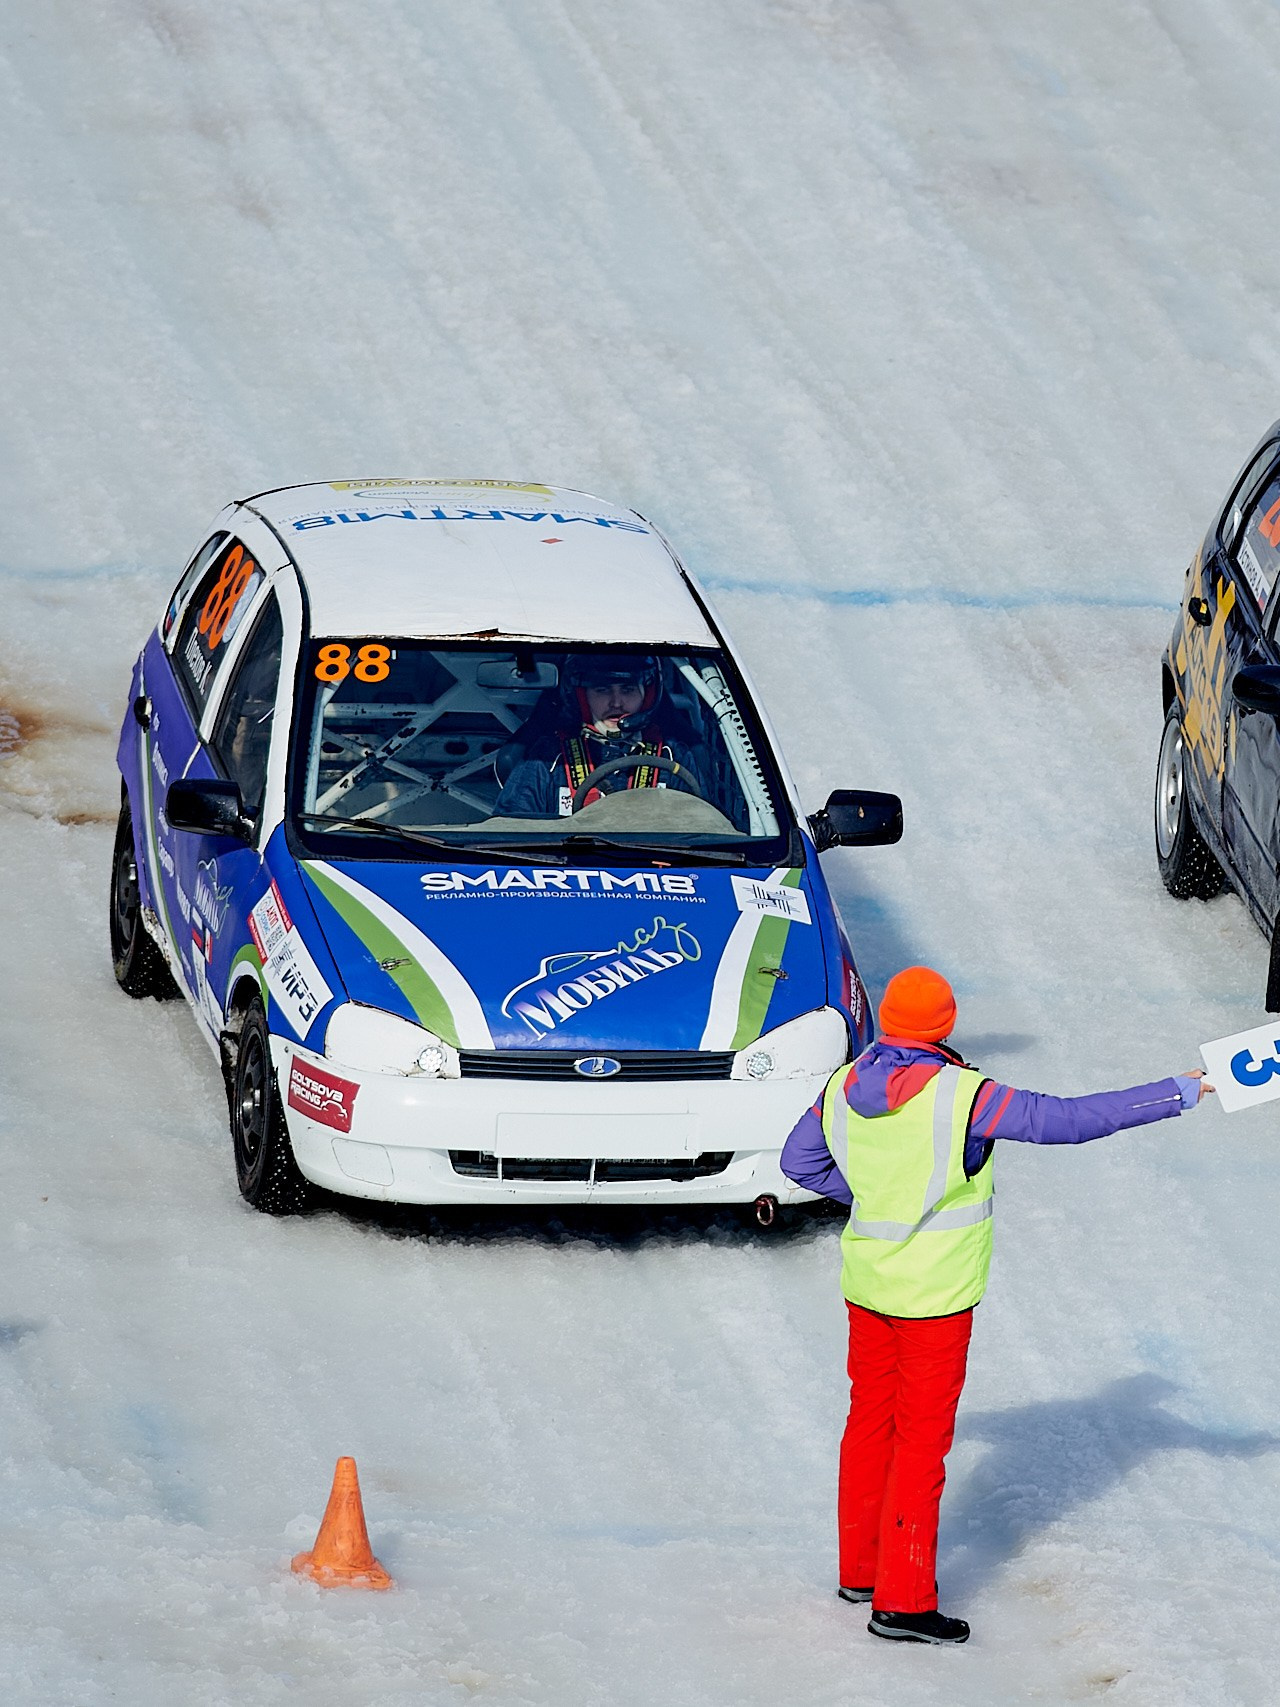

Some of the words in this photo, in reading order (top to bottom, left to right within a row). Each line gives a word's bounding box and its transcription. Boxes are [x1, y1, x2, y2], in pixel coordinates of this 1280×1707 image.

[295, 510, 651, 535] SMARTM18
[199, 545, 255, 650] 88
[314, 643, 391, 683] 88
[425, 891, 632, 901] РЕКЛАМНО-ПРОИЗВОДСТВЕННАЯ
[634, 893, 706, 904] КОМПАНИЯ
[513, 947, 685, 1041] МОБИЛЬ
[290, 1081, 322, 1105] RACING
[291, 1069, 344, 1102] GOLTSOVA
